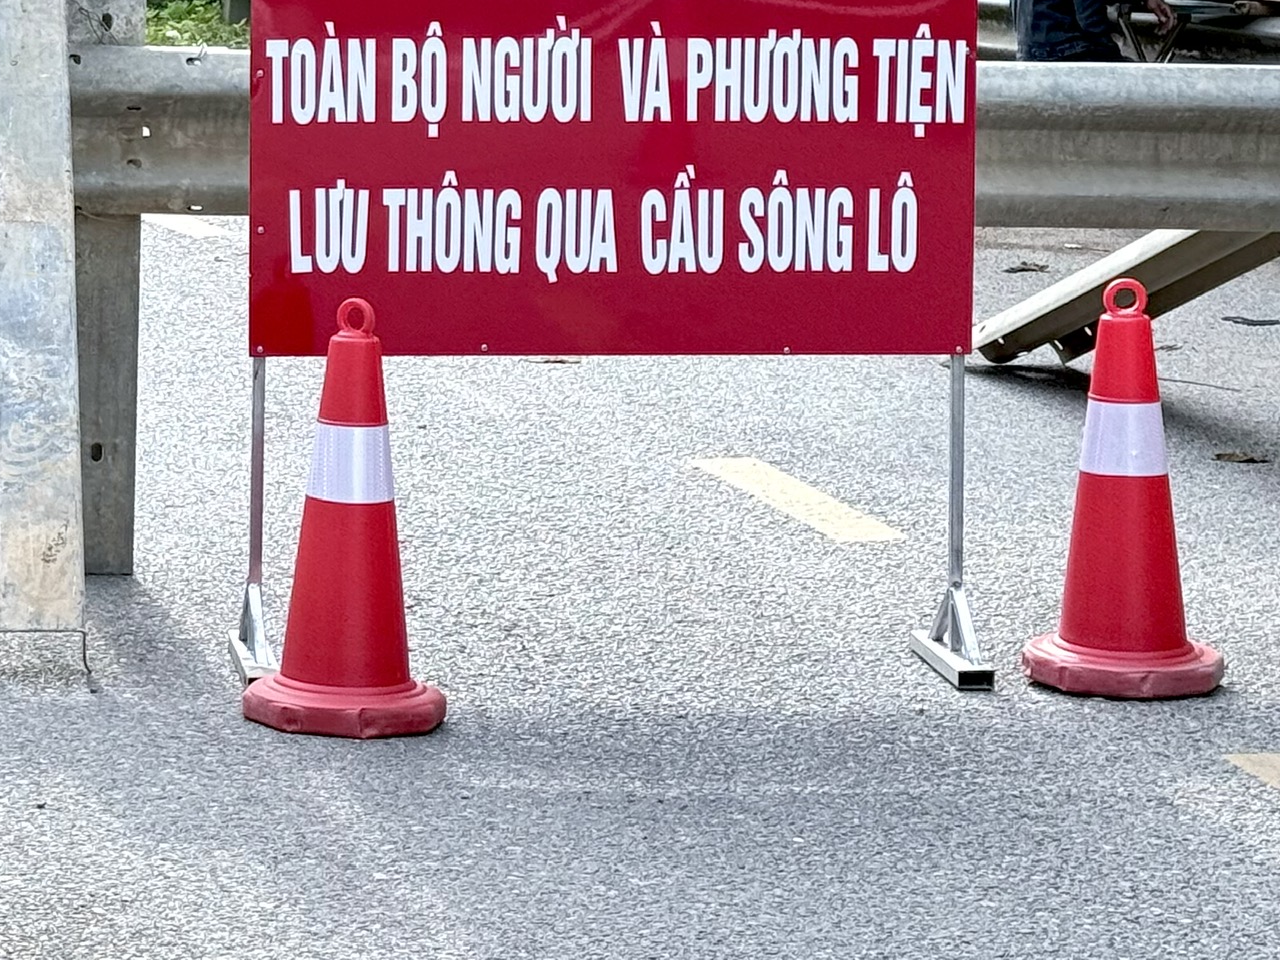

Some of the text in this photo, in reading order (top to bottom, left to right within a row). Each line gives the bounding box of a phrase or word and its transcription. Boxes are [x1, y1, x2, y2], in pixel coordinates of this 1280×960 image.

[265, 16, 967, 138] TOÀN BỘ NGƯỜI VÀ PHƯƠNG TIỆN
[288, 165, 918, 283] LƯU THÔNG QUA CẦU SÔNG LÔ
